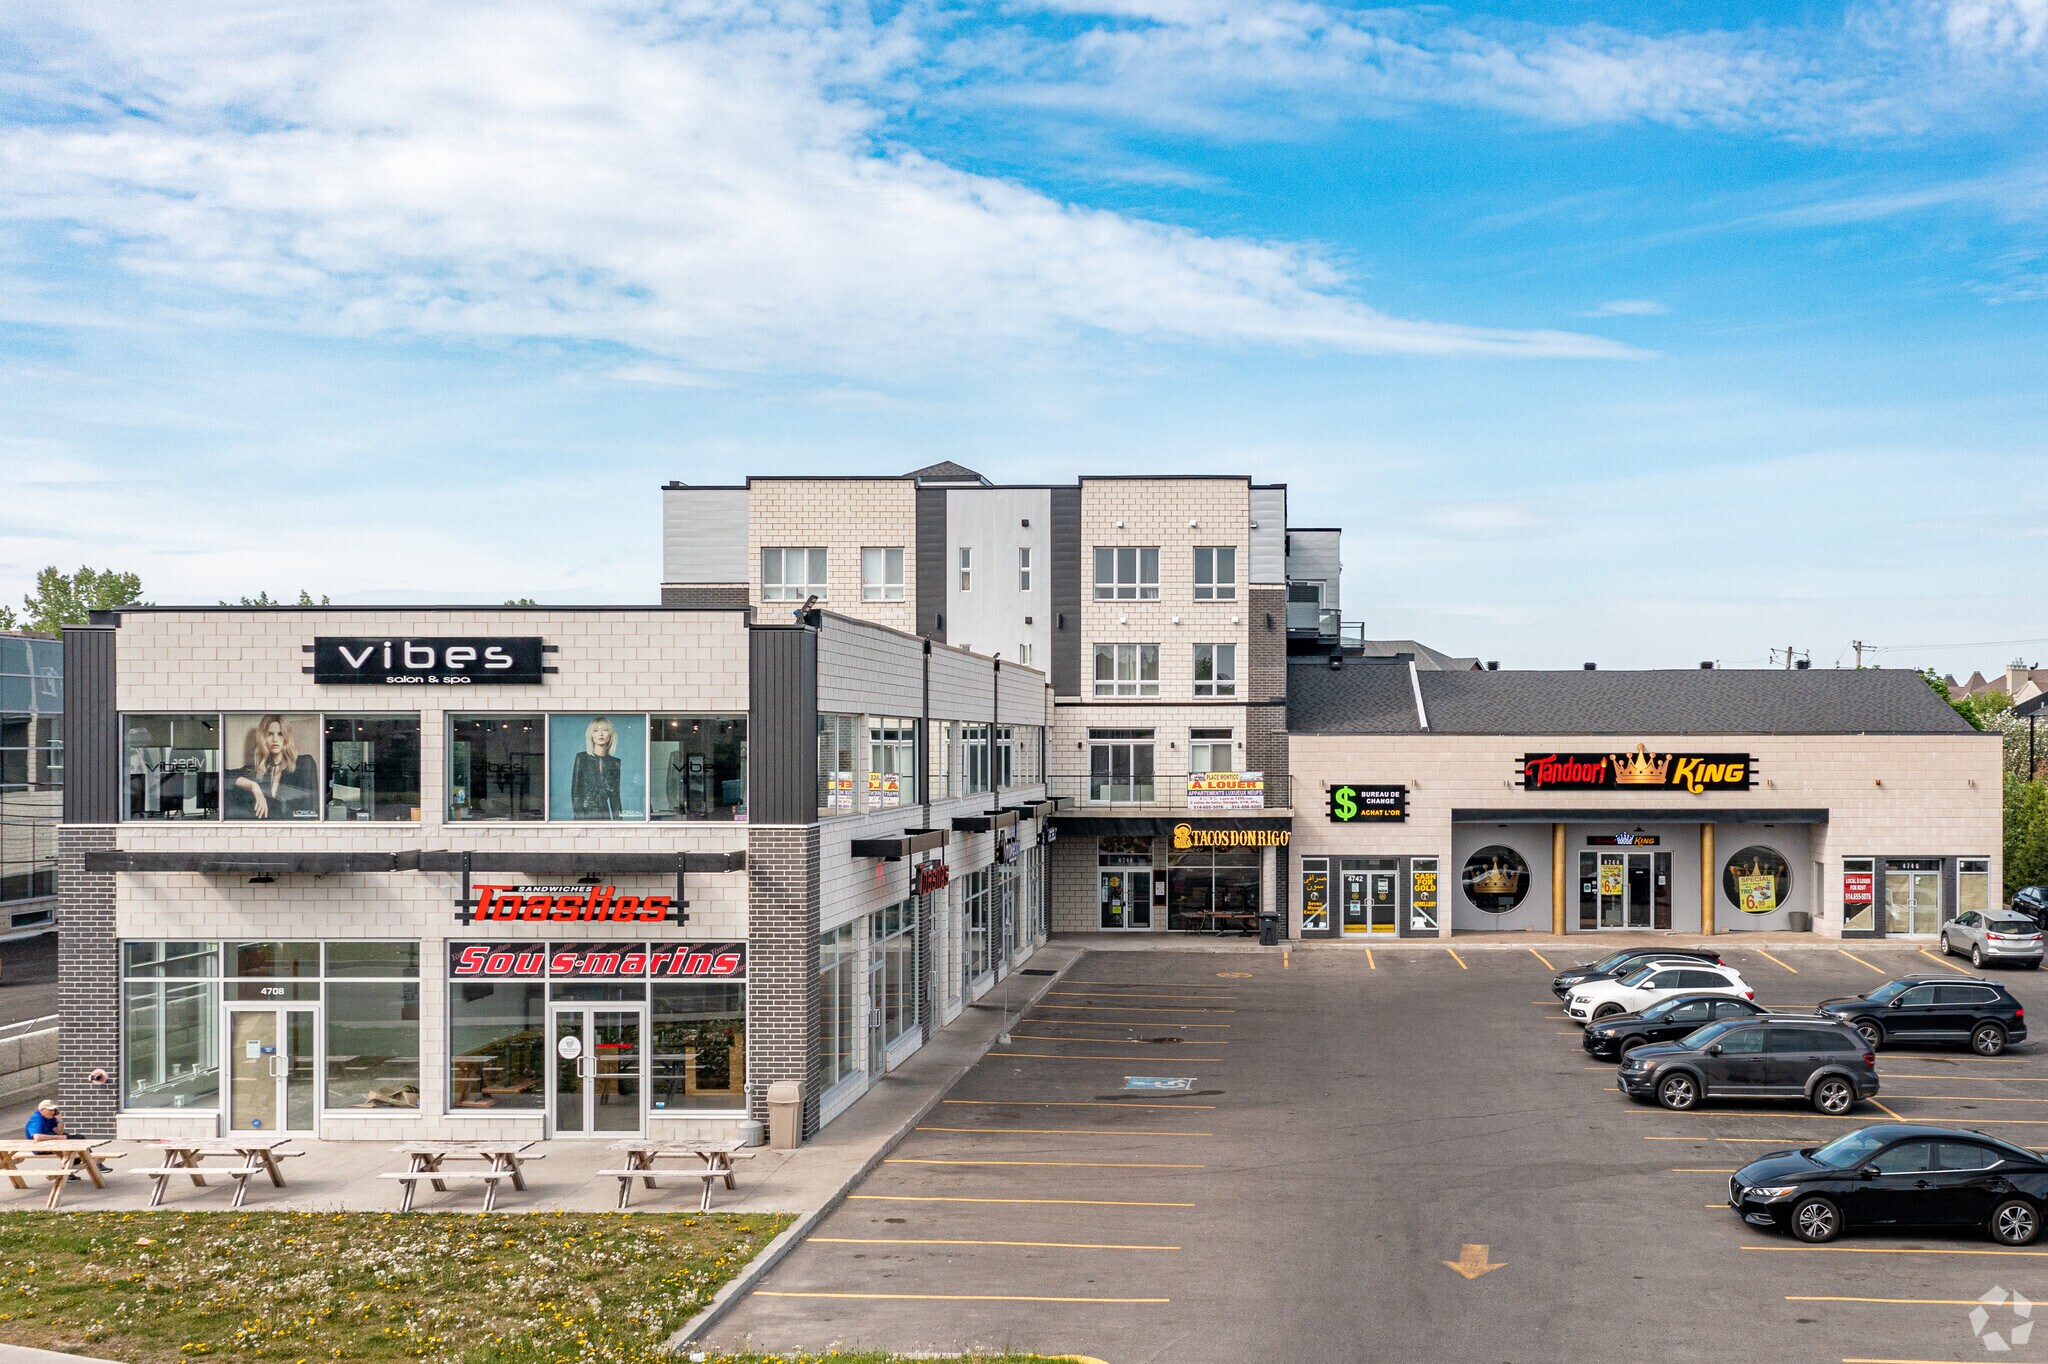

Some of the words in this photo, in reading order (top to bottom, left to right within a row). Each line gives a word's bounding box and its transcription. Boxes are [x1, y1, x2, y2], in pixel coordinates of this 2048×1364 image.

[338, 640, 514, 669] vibes
[386, 675, 424, 684] salon
[428, 675, 439, 684] &
[443, 675, 471, 685] spa
[145, 761, 199, 772] vibes
[1525, 753, 1608, 787] Tandoori
[1192, 779, 1202, 789] À
[1207, 781, 1257, 789] LOUER
[1334, 786, 1357, 821] $
[518, 885, 593, 893] SANDWICHES
[472, 884, 672, 923] Toasties
[455, 946, 741, 975] Sous-marins
[260, 987, 285, 995] 4708
